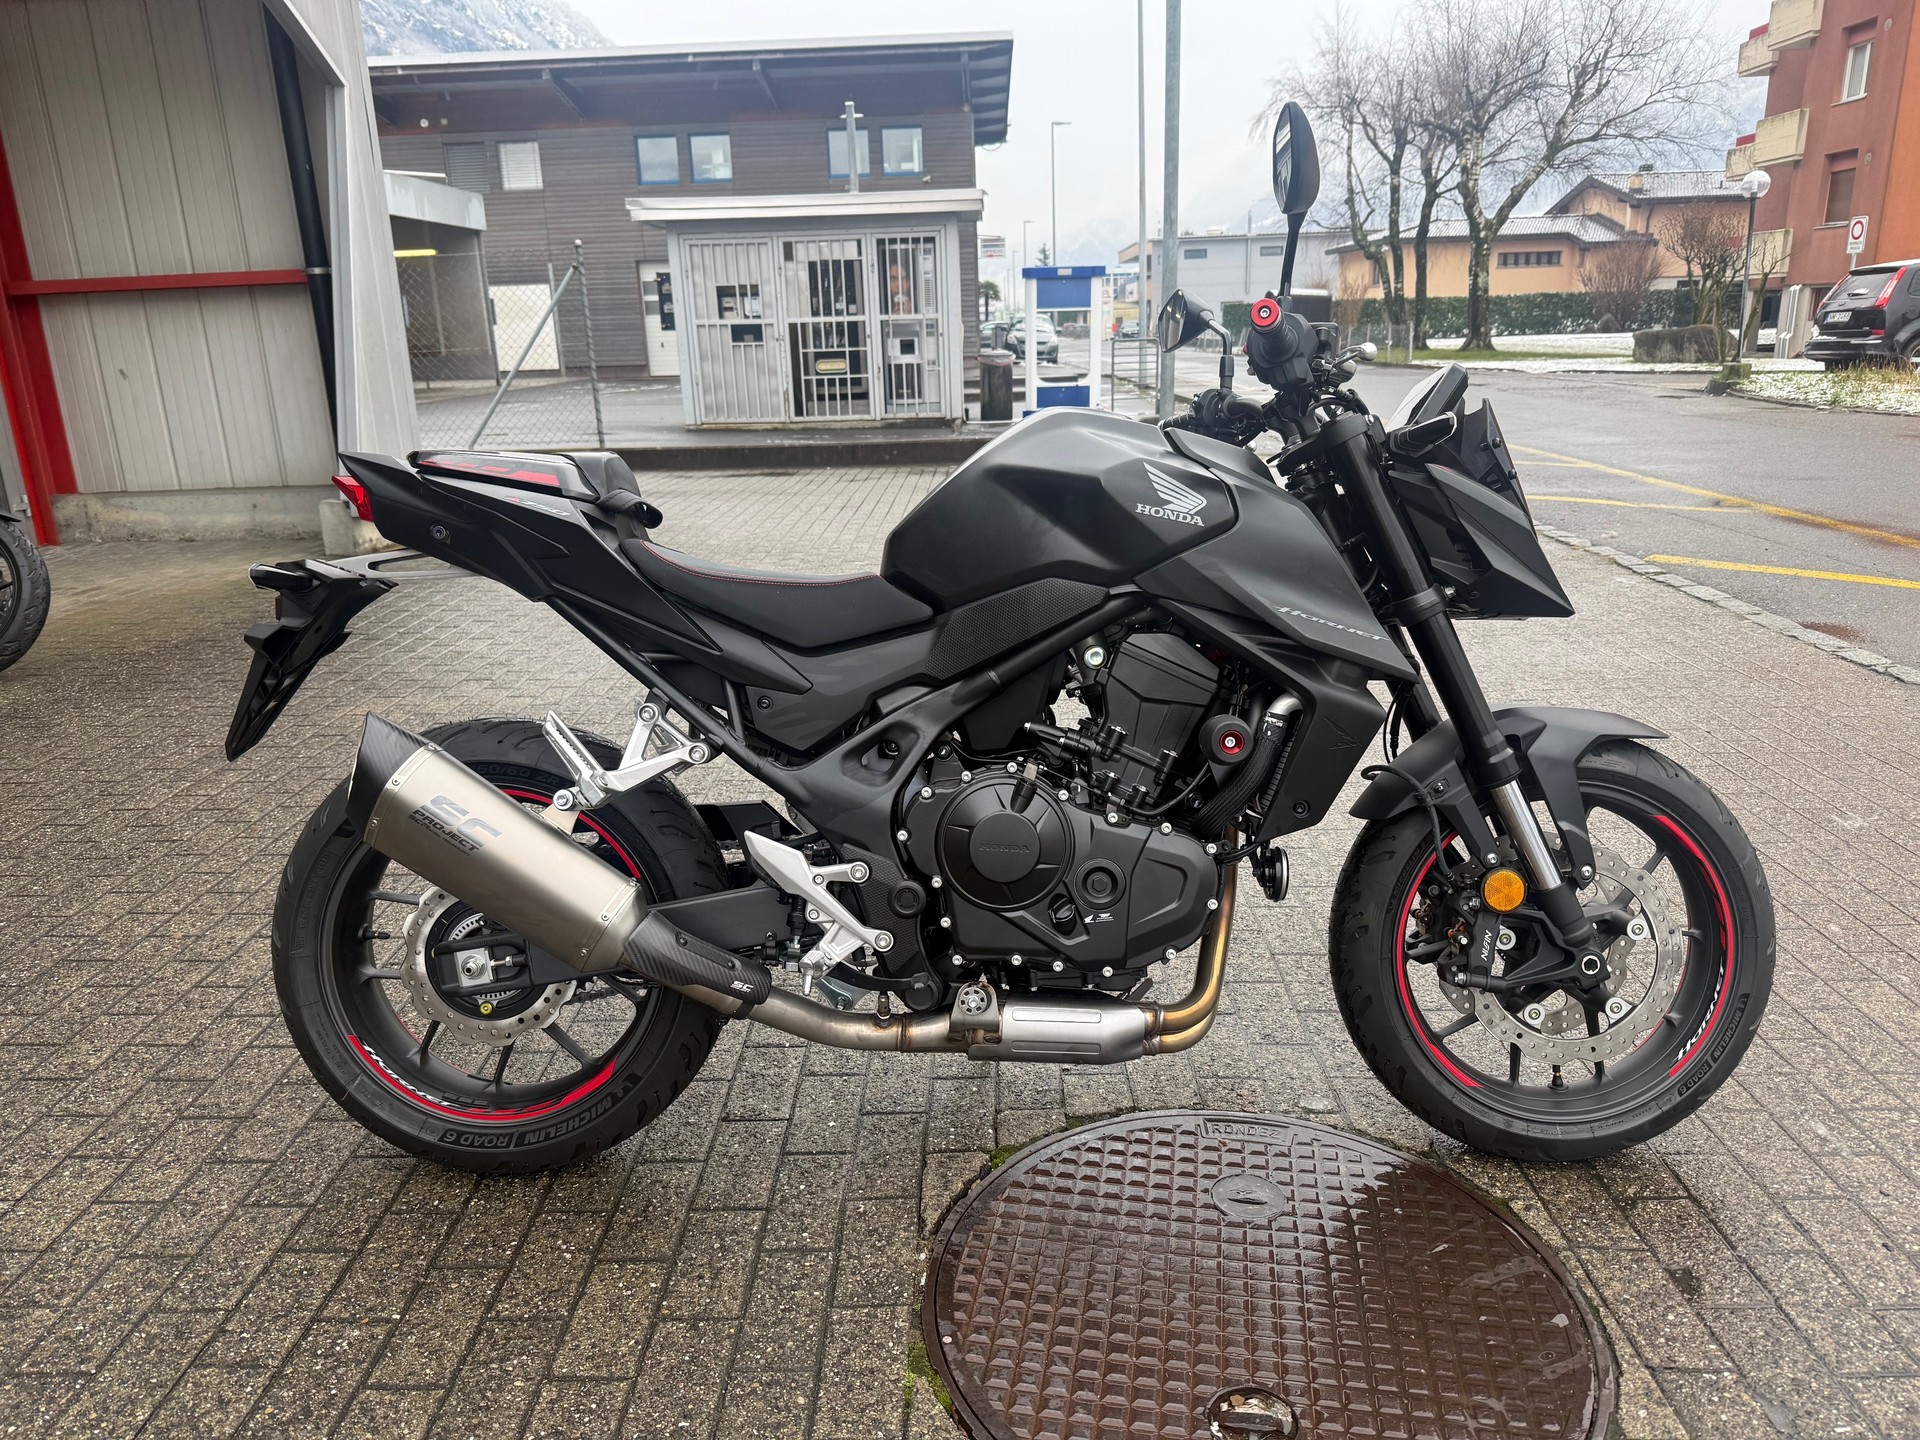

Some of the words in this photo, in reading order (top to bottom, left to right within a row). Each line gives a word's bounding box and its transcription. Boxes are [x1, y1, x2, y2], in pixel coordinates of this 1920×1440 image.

[1135, 503, 1204, 526] HONDA
[412, 809, 480, 851] PROJECT
[419, 794, 503, 848] SC
[979, 843, 1030, 853] HONDA
[1714, 1009, 1743, 1059] MICHELIN
[1686, 1062, 1710, 1087] ROAD
[523, 1095, 613, 1145] MICHELIN
[444, 1131, 455, 1142] 6
[460, 1132, 510, 1148] ROAD
